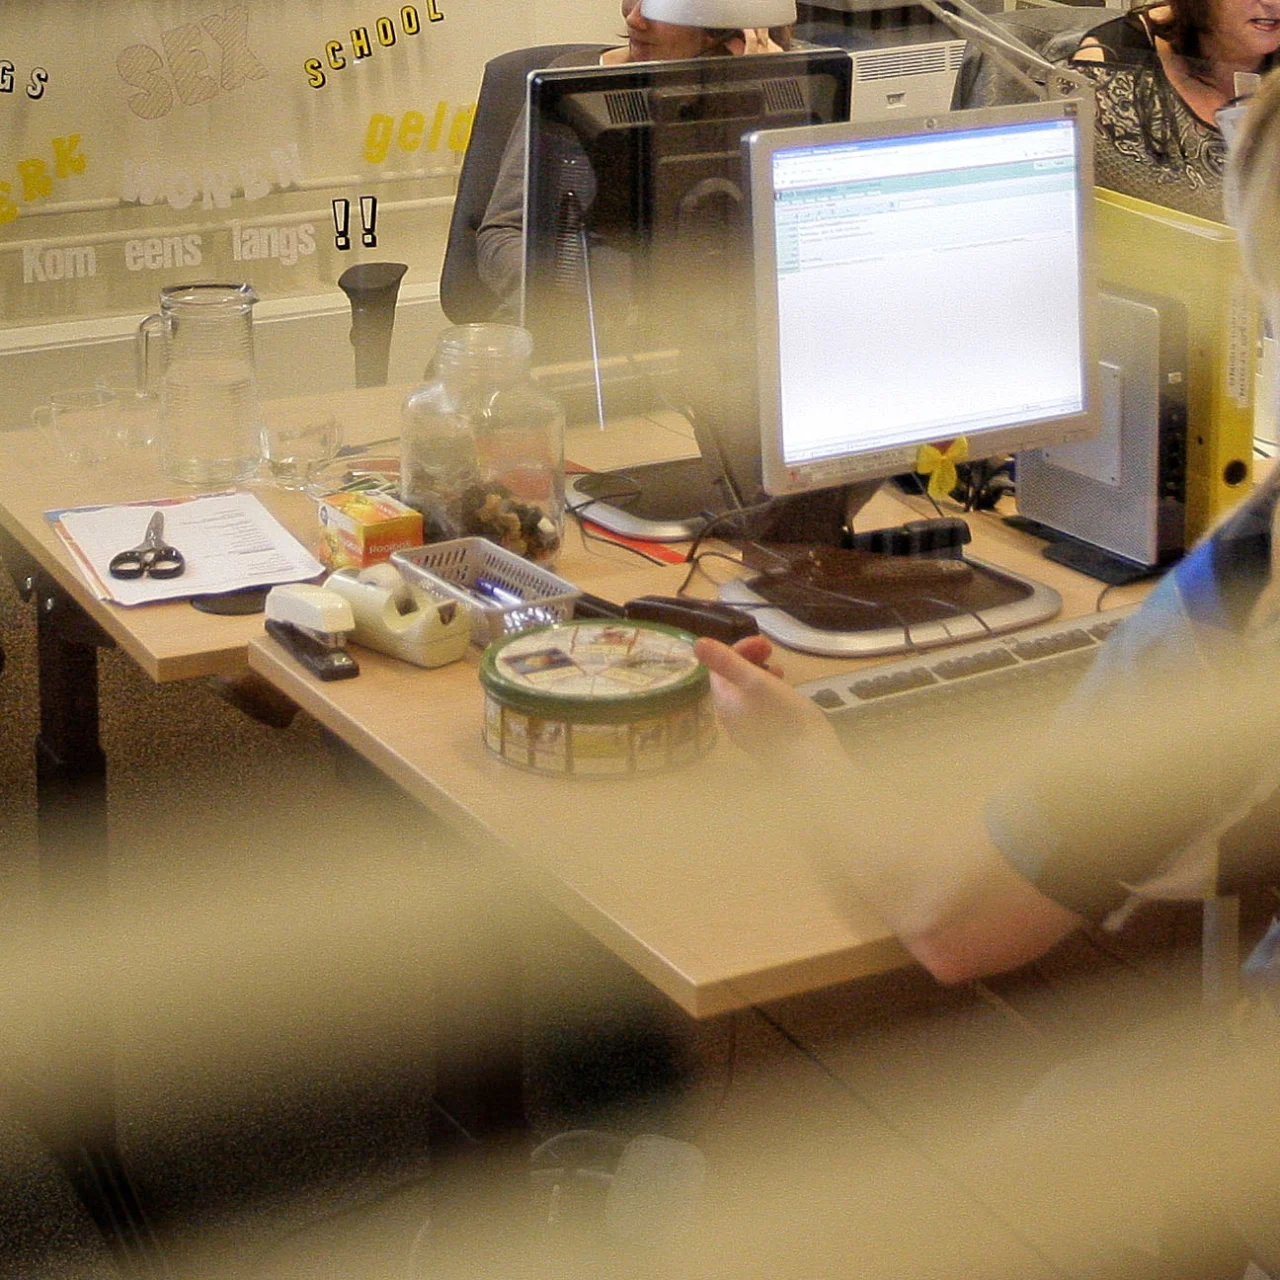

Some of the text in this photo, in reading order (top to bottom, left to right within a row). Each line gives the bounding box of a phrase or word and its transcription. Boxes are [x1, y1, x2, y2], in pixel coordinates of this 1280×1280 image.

[116, 4, 268, 121] SEX
[22, 242, 97, 284] Kom
[124, 230, 203, 272] eens
[231, 220, 317, 266] langs
